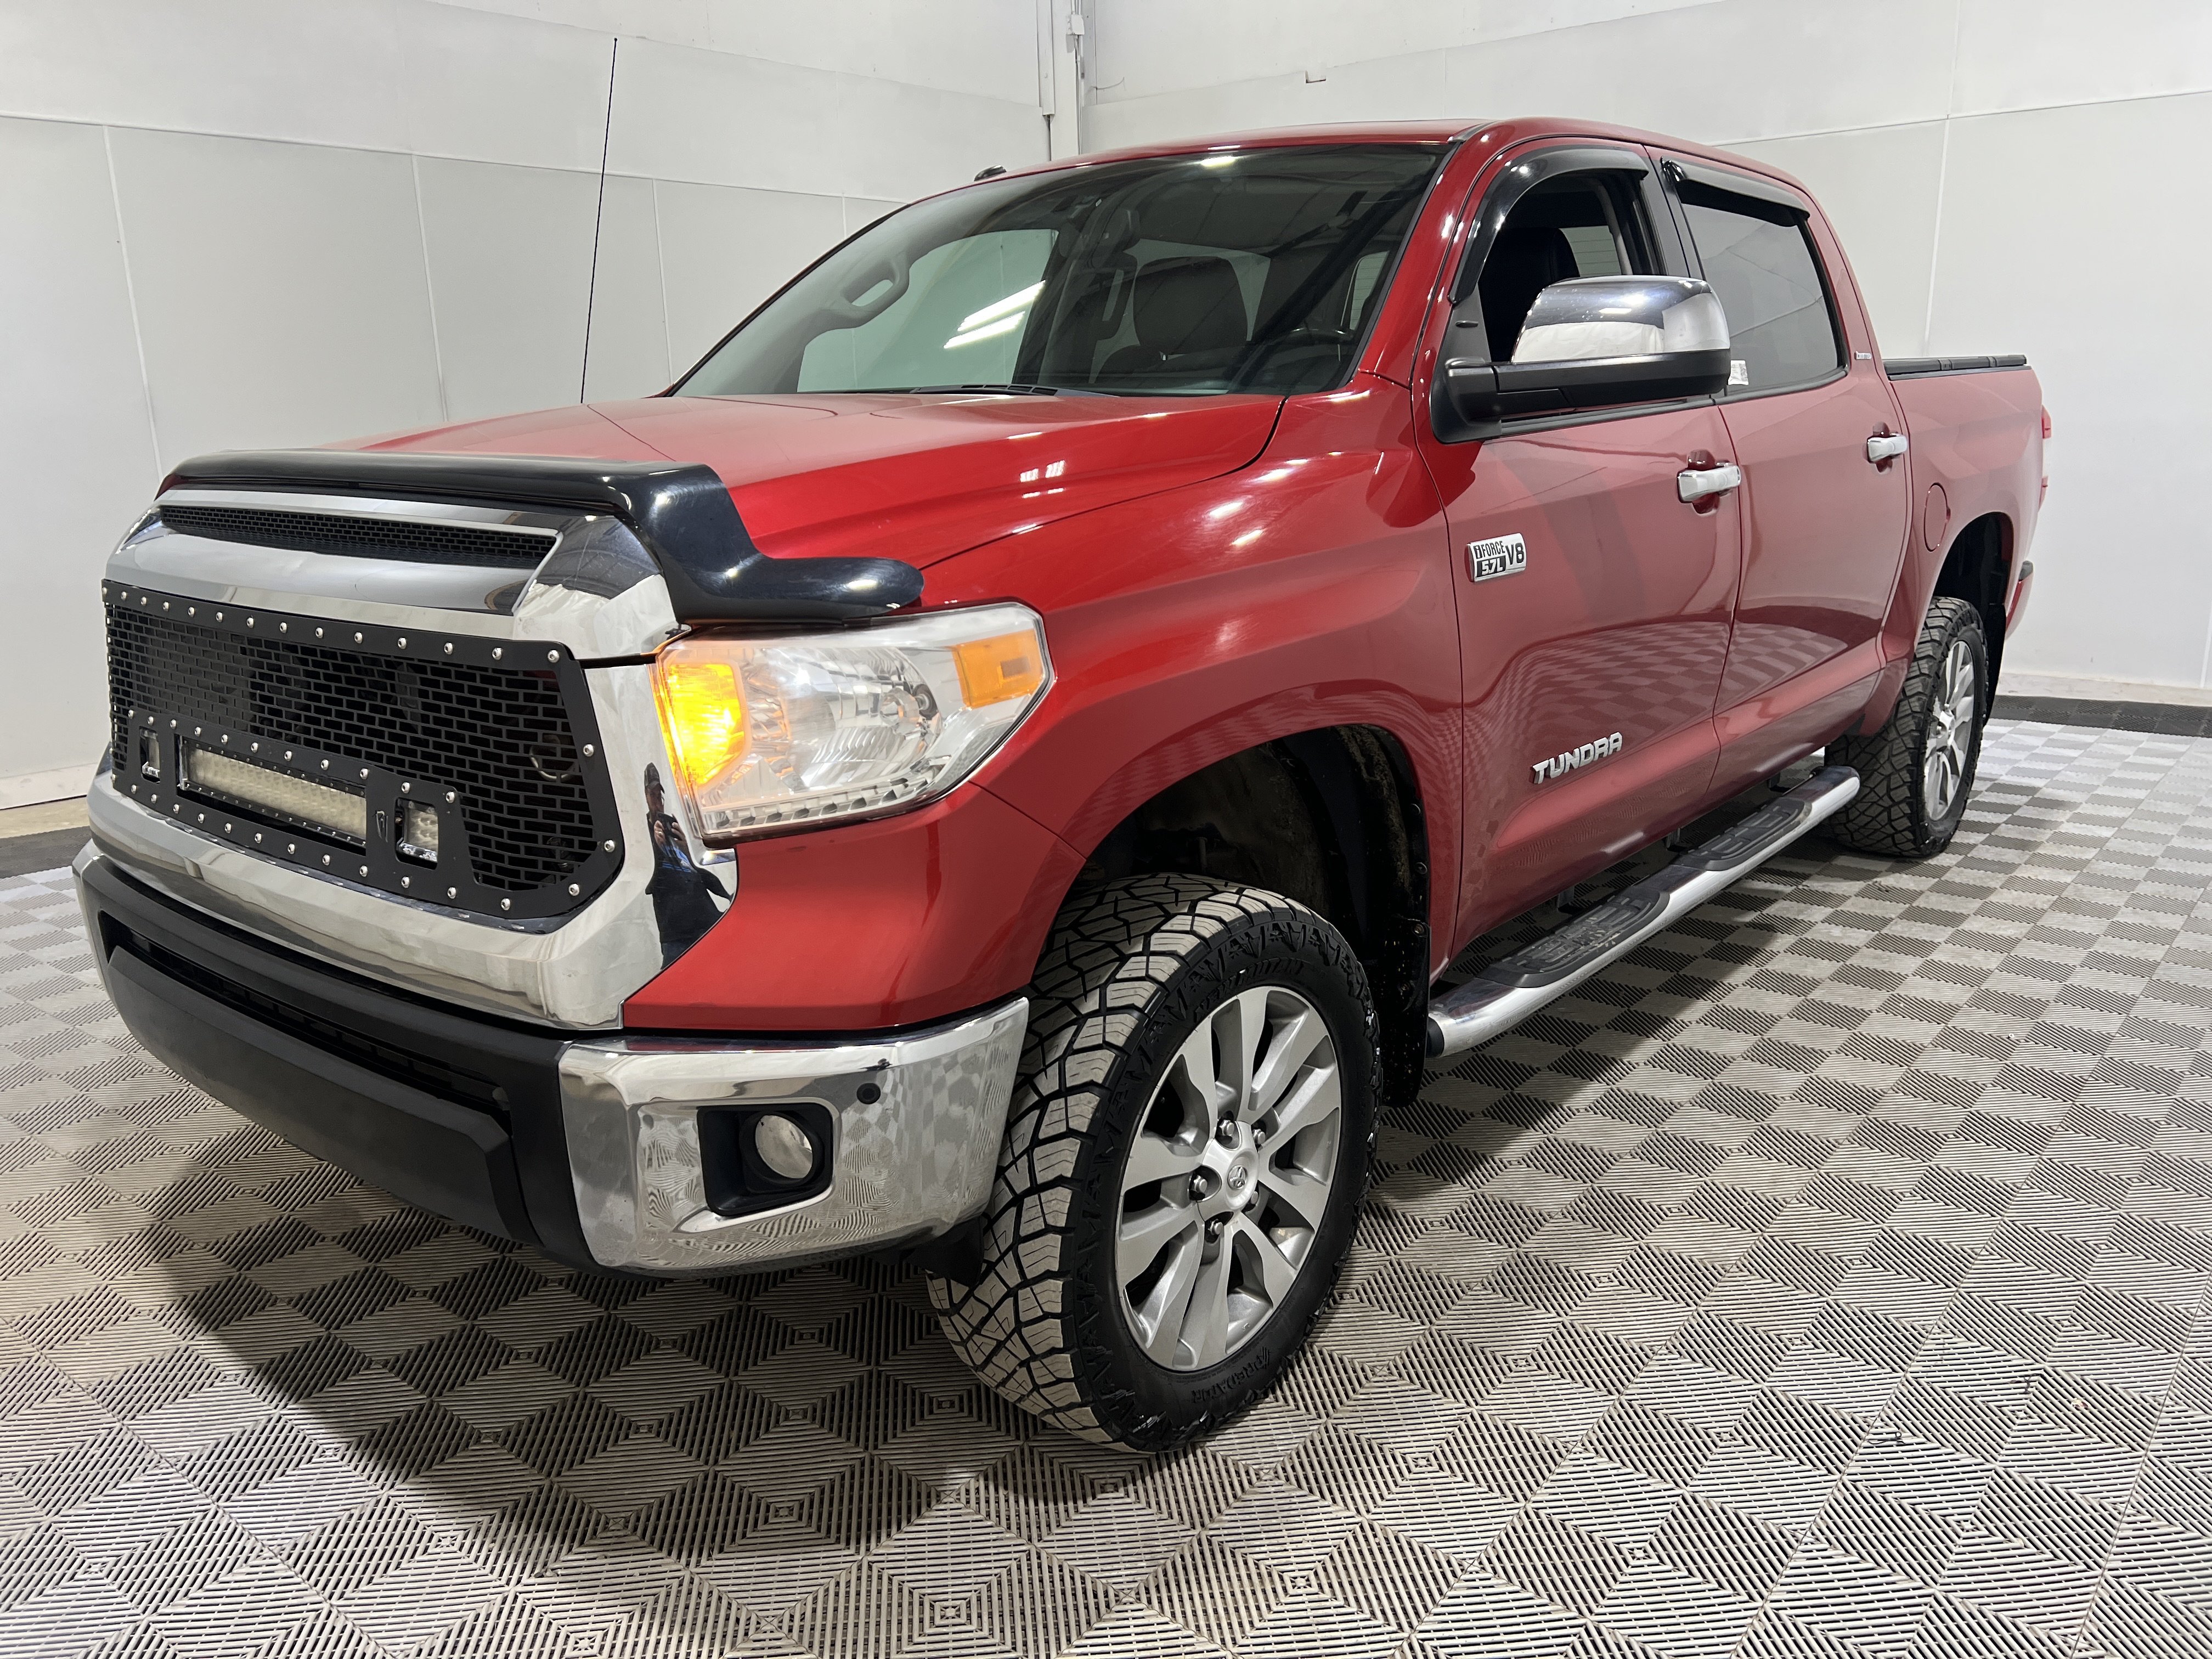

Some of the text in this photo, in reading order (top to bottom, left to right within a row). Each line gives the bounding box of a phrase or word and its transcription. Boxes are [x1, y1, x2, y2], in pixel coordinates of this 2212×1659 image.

[1505, 543, 1524, 565] V8
[1481, 558, 1504, 575] 5.7L
[1532, 732, 1623, 785] TUNDRA
